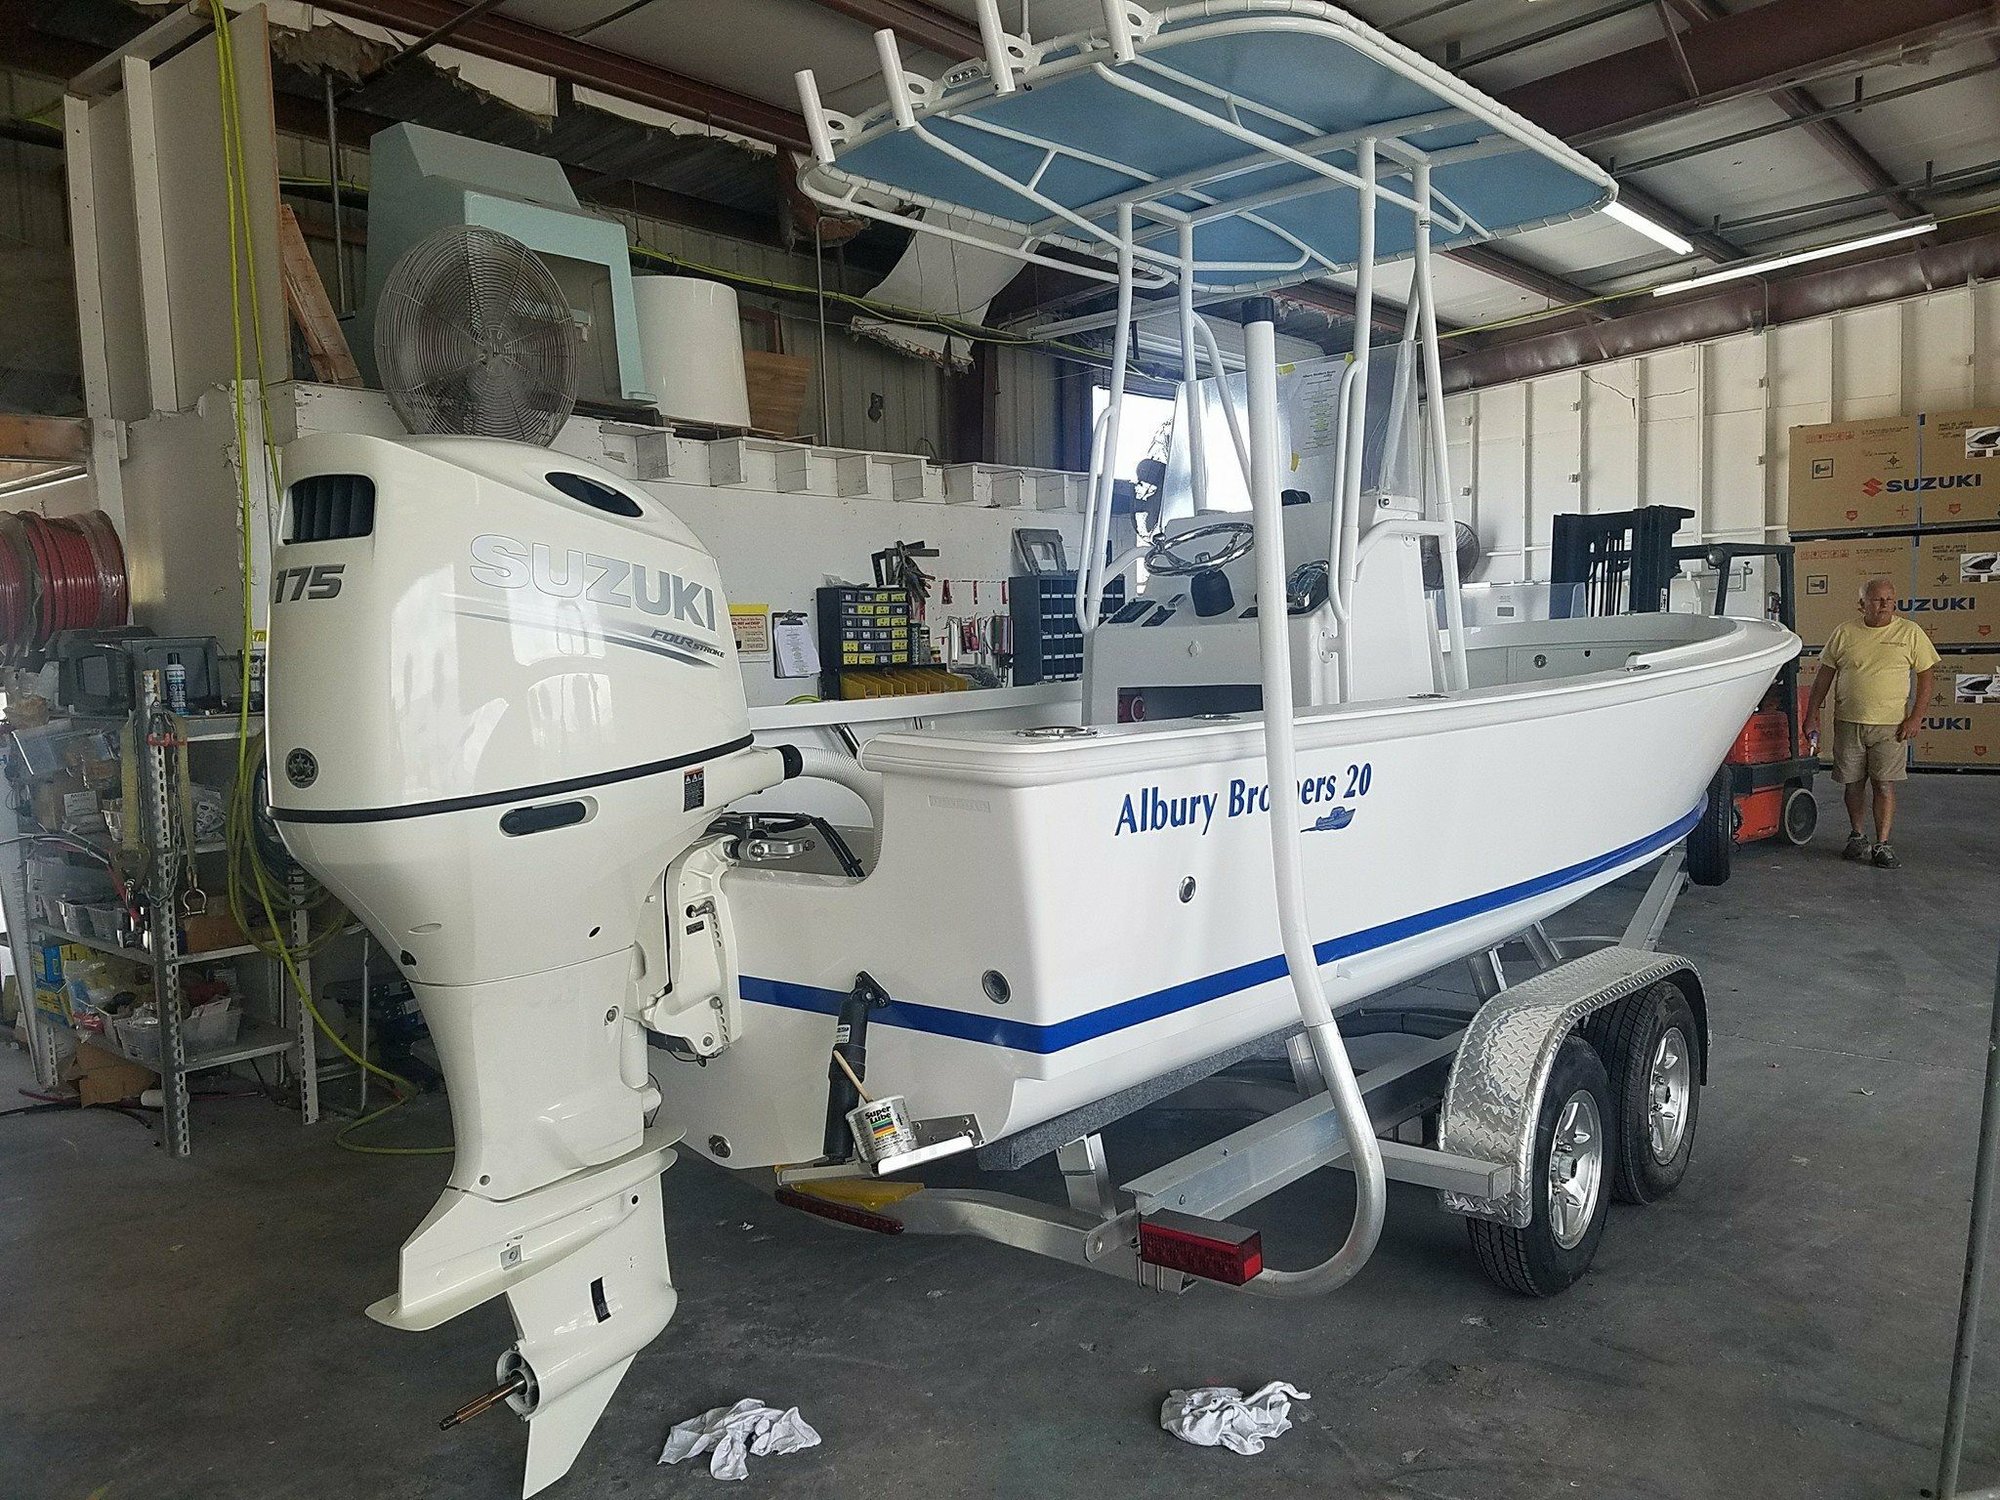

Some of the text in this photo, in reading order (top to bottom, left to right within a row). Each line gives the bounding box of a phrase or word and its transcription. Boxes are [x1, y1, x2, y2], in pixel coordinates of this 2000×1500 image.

[1886, 473, 1982, 493] SUZUKI
[274, 564, 346, 604] 175
[470, 533, 717, 632] SUZUKI
[1894, 597, 1975, 612] UZUKI
[651, 629, 726, 659] FOUR STROKE
[1114, 762, 1372, 836] Albury Broers 20
[864, 1105, 892, 1120] Super
[869, 1112, 892, 1124] Lube
